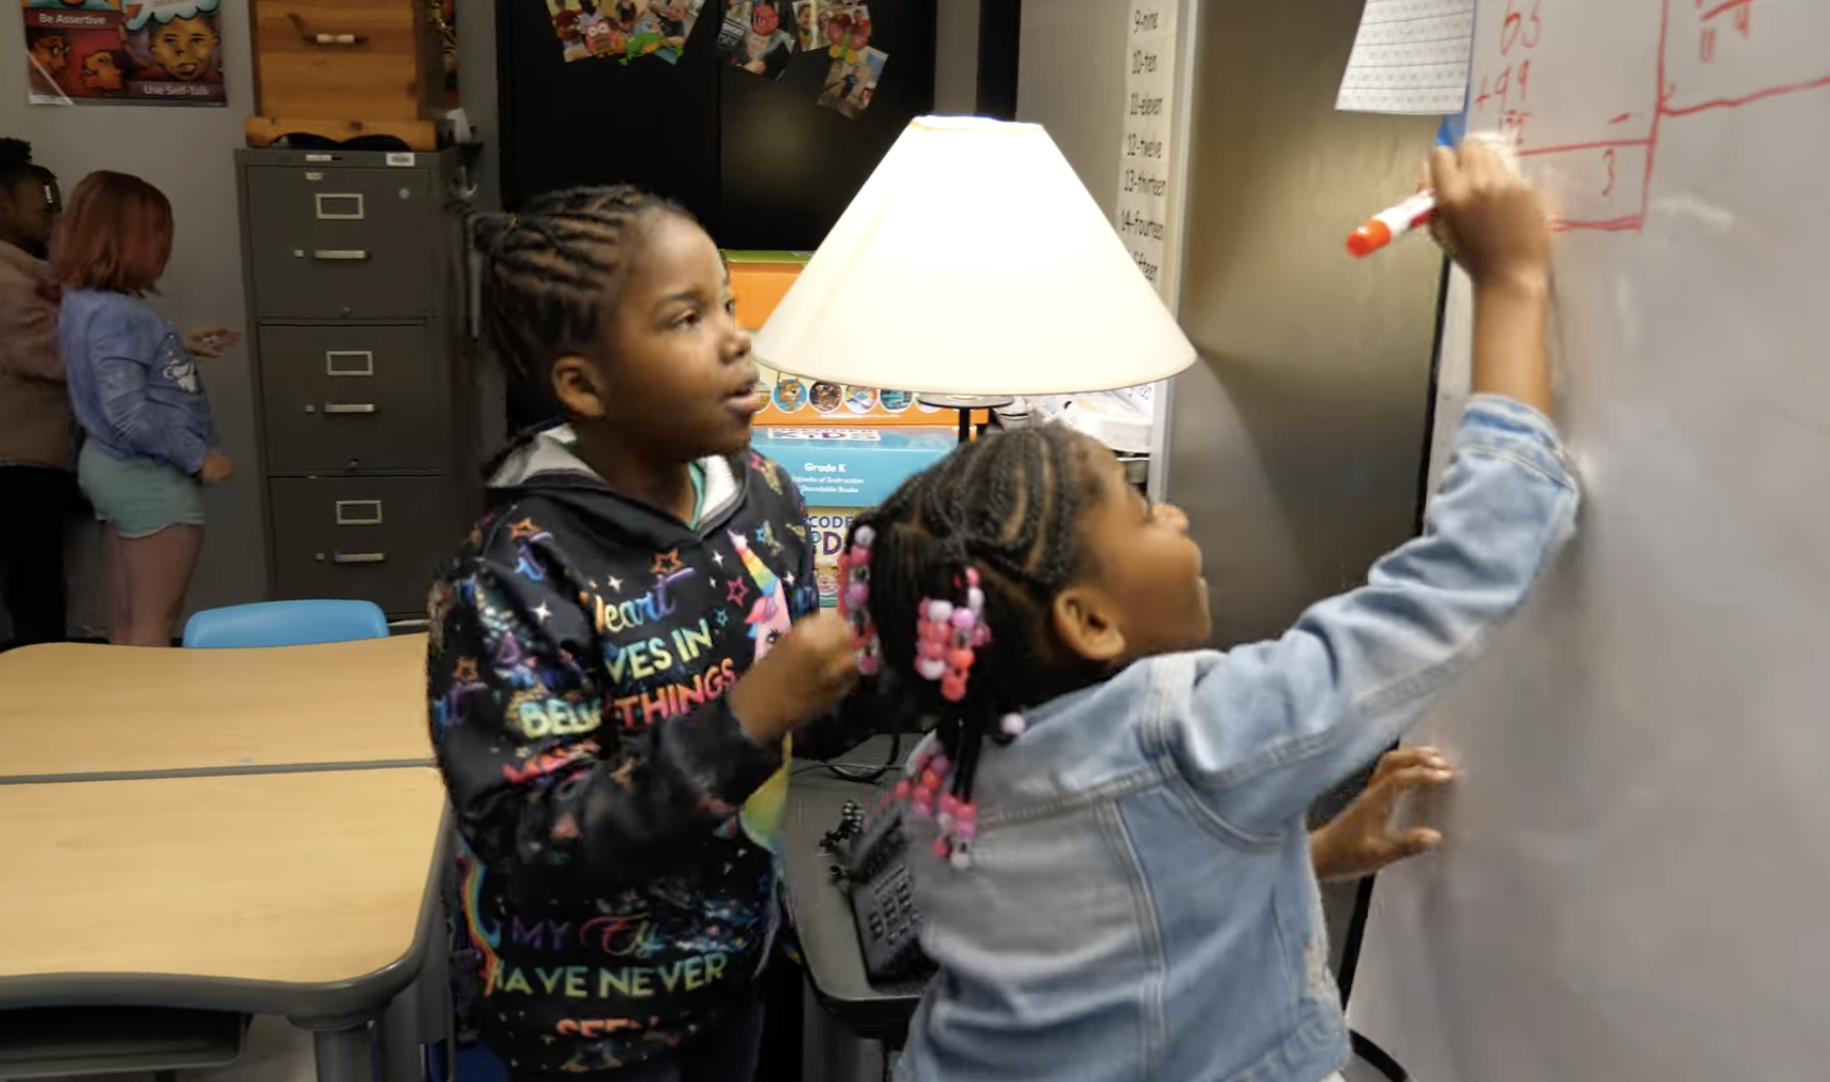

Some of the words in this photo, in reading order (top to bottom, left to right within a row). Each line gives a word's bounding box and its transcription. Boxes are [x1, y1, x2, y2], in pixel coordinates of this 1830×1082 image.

[39, 13, 53, 24] Be
[55, 14, 106, 25] Assertive
[144, 85, 164, 95] Use
[166, 86, 210, 96] Self-Talk
[1124, 169, 1166, 196] 13-thirteen
[1121, 210, 1164, 240] 14-fourteen
[804, 462, 837, 473] Grade
[838, 463, 847, 473] K
[818, 476, 827, 484] of
[826, 477, 865, 485] Instruction
[838, 486, 859, 494] Books
[671, 618, 714, 663] IN
[613, 657, 736, 729] THINGS
[511, 916, 572, 951] MY
[598, 953, 728, 998] NEVER
